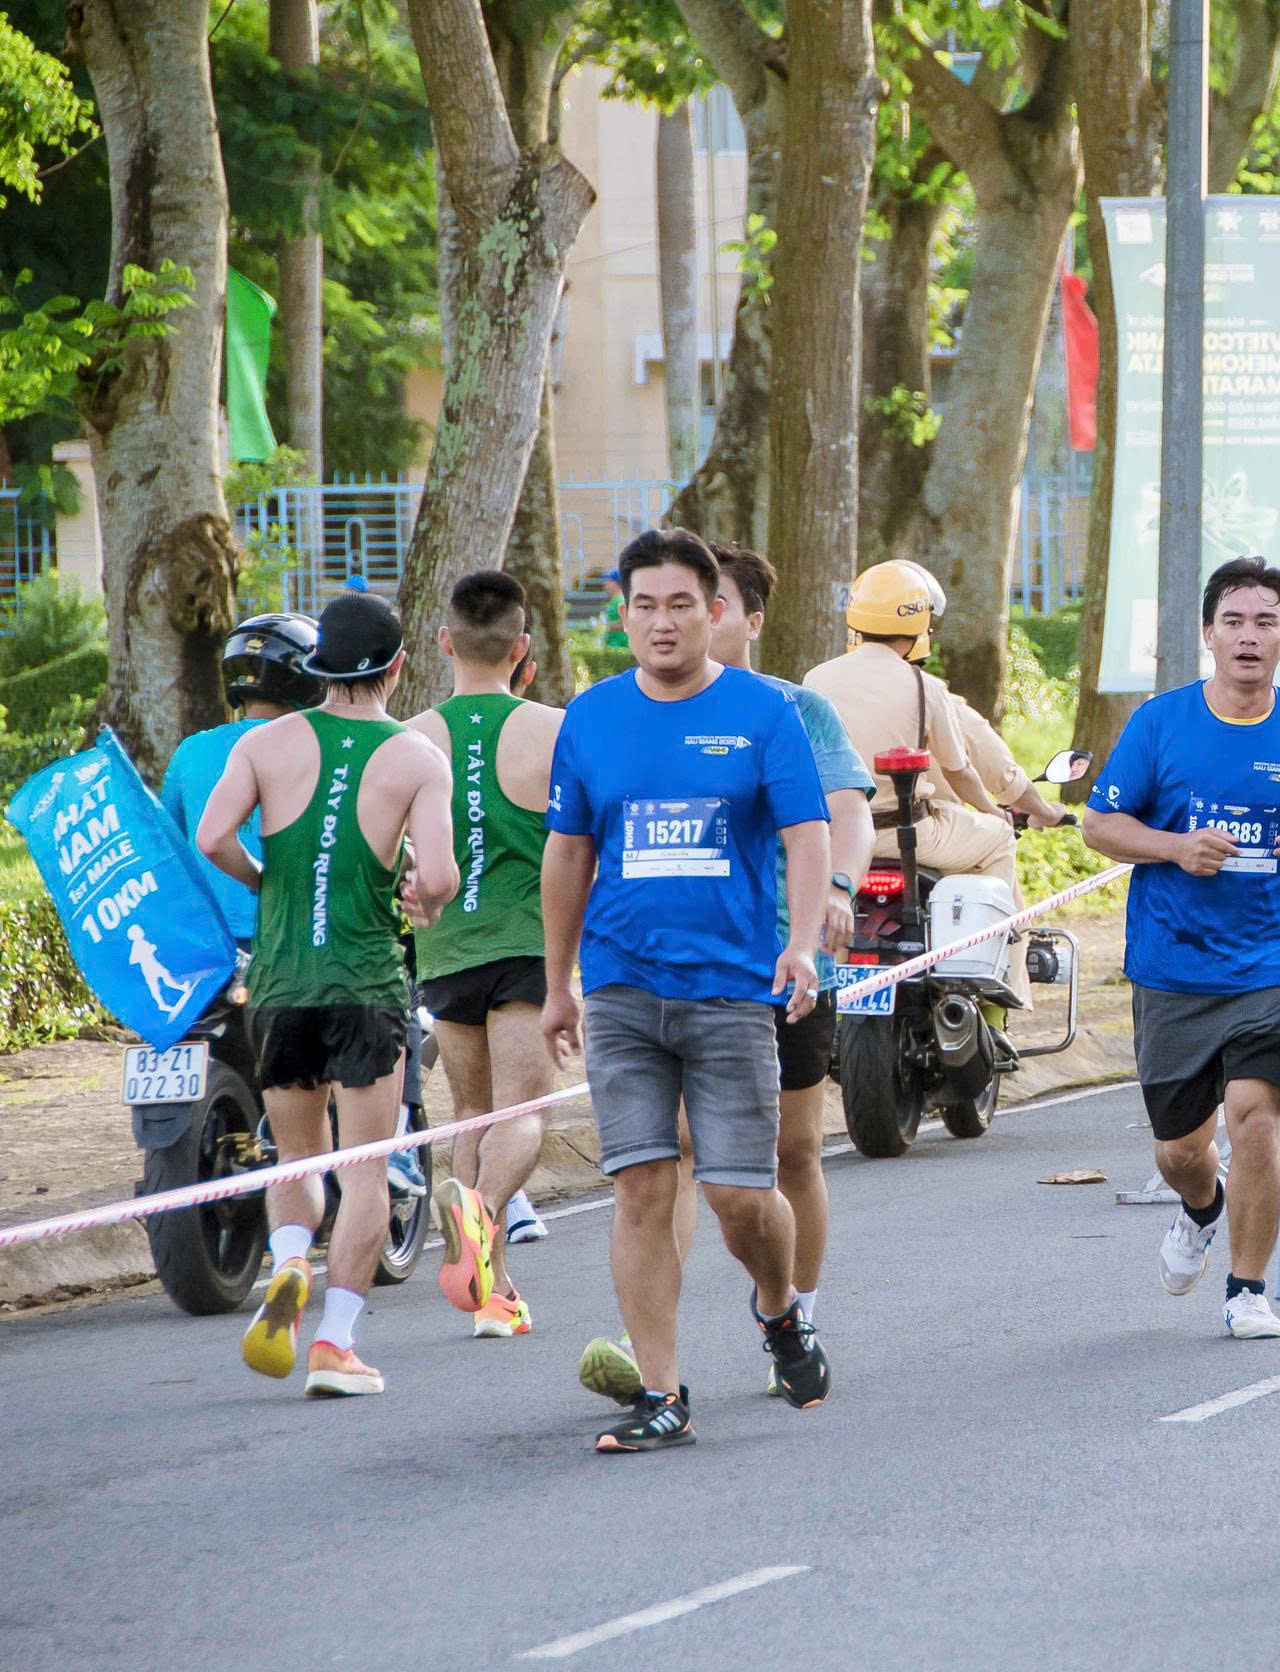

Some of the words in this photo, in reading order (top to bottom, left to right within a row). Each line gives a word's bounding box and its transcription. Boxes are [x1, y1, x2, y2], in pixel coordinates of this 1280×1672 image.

[646, 819, 703, 845] 15217
[1189, 815, 1198, 832] 10K
[86, 838, 135, 885] MALE
[463, 827, 484, 912] RUNNING
[82, 870, 158, 944] 10KM
[312, 853, 331, 947] RUNNING
[136, 1047, 192, 1073] 83-Z1
[127, 1073, 200, 1100] 022.30
